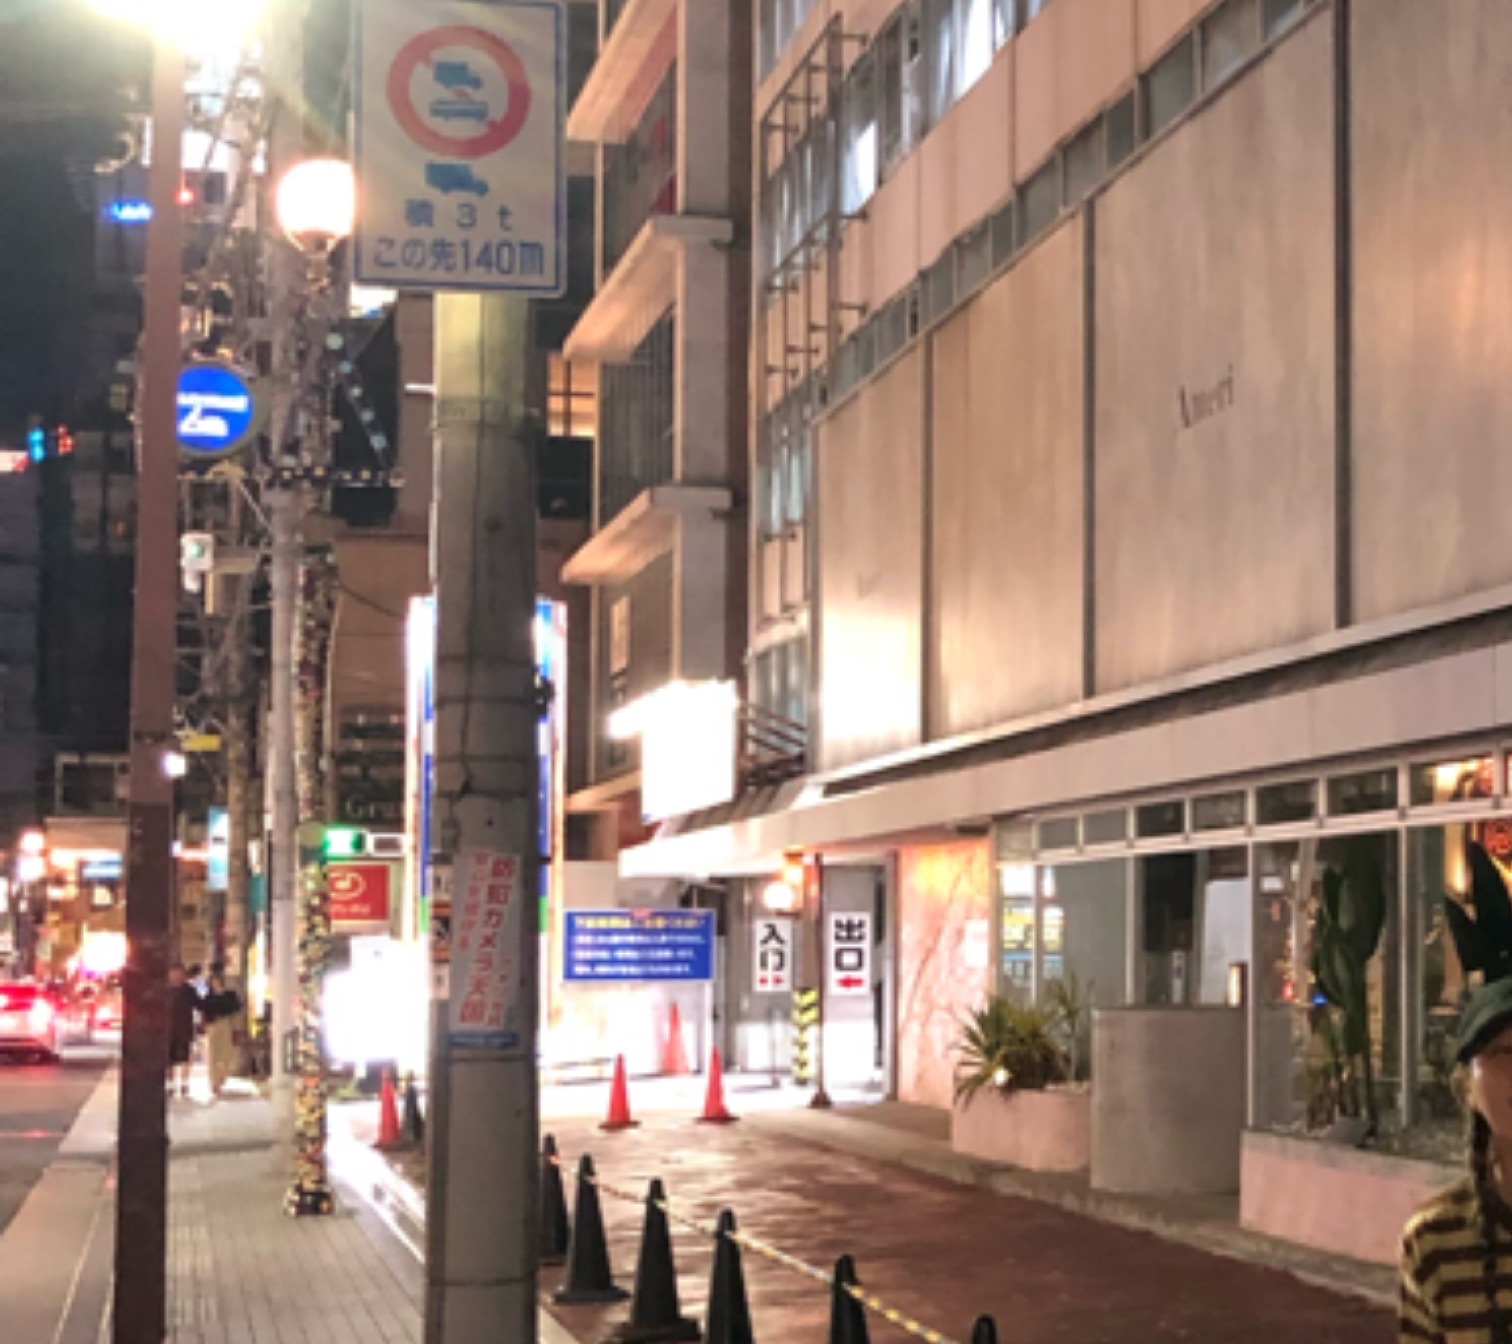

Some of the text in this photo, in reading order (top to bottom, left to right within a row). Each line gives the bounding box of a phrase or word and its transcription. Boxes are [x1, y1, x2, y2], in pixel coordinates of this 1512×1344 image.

[373, 237, 544, 276] この先140m
[759, 922, 785, 972] 入口
[833, 918, 866, 972] 出口
